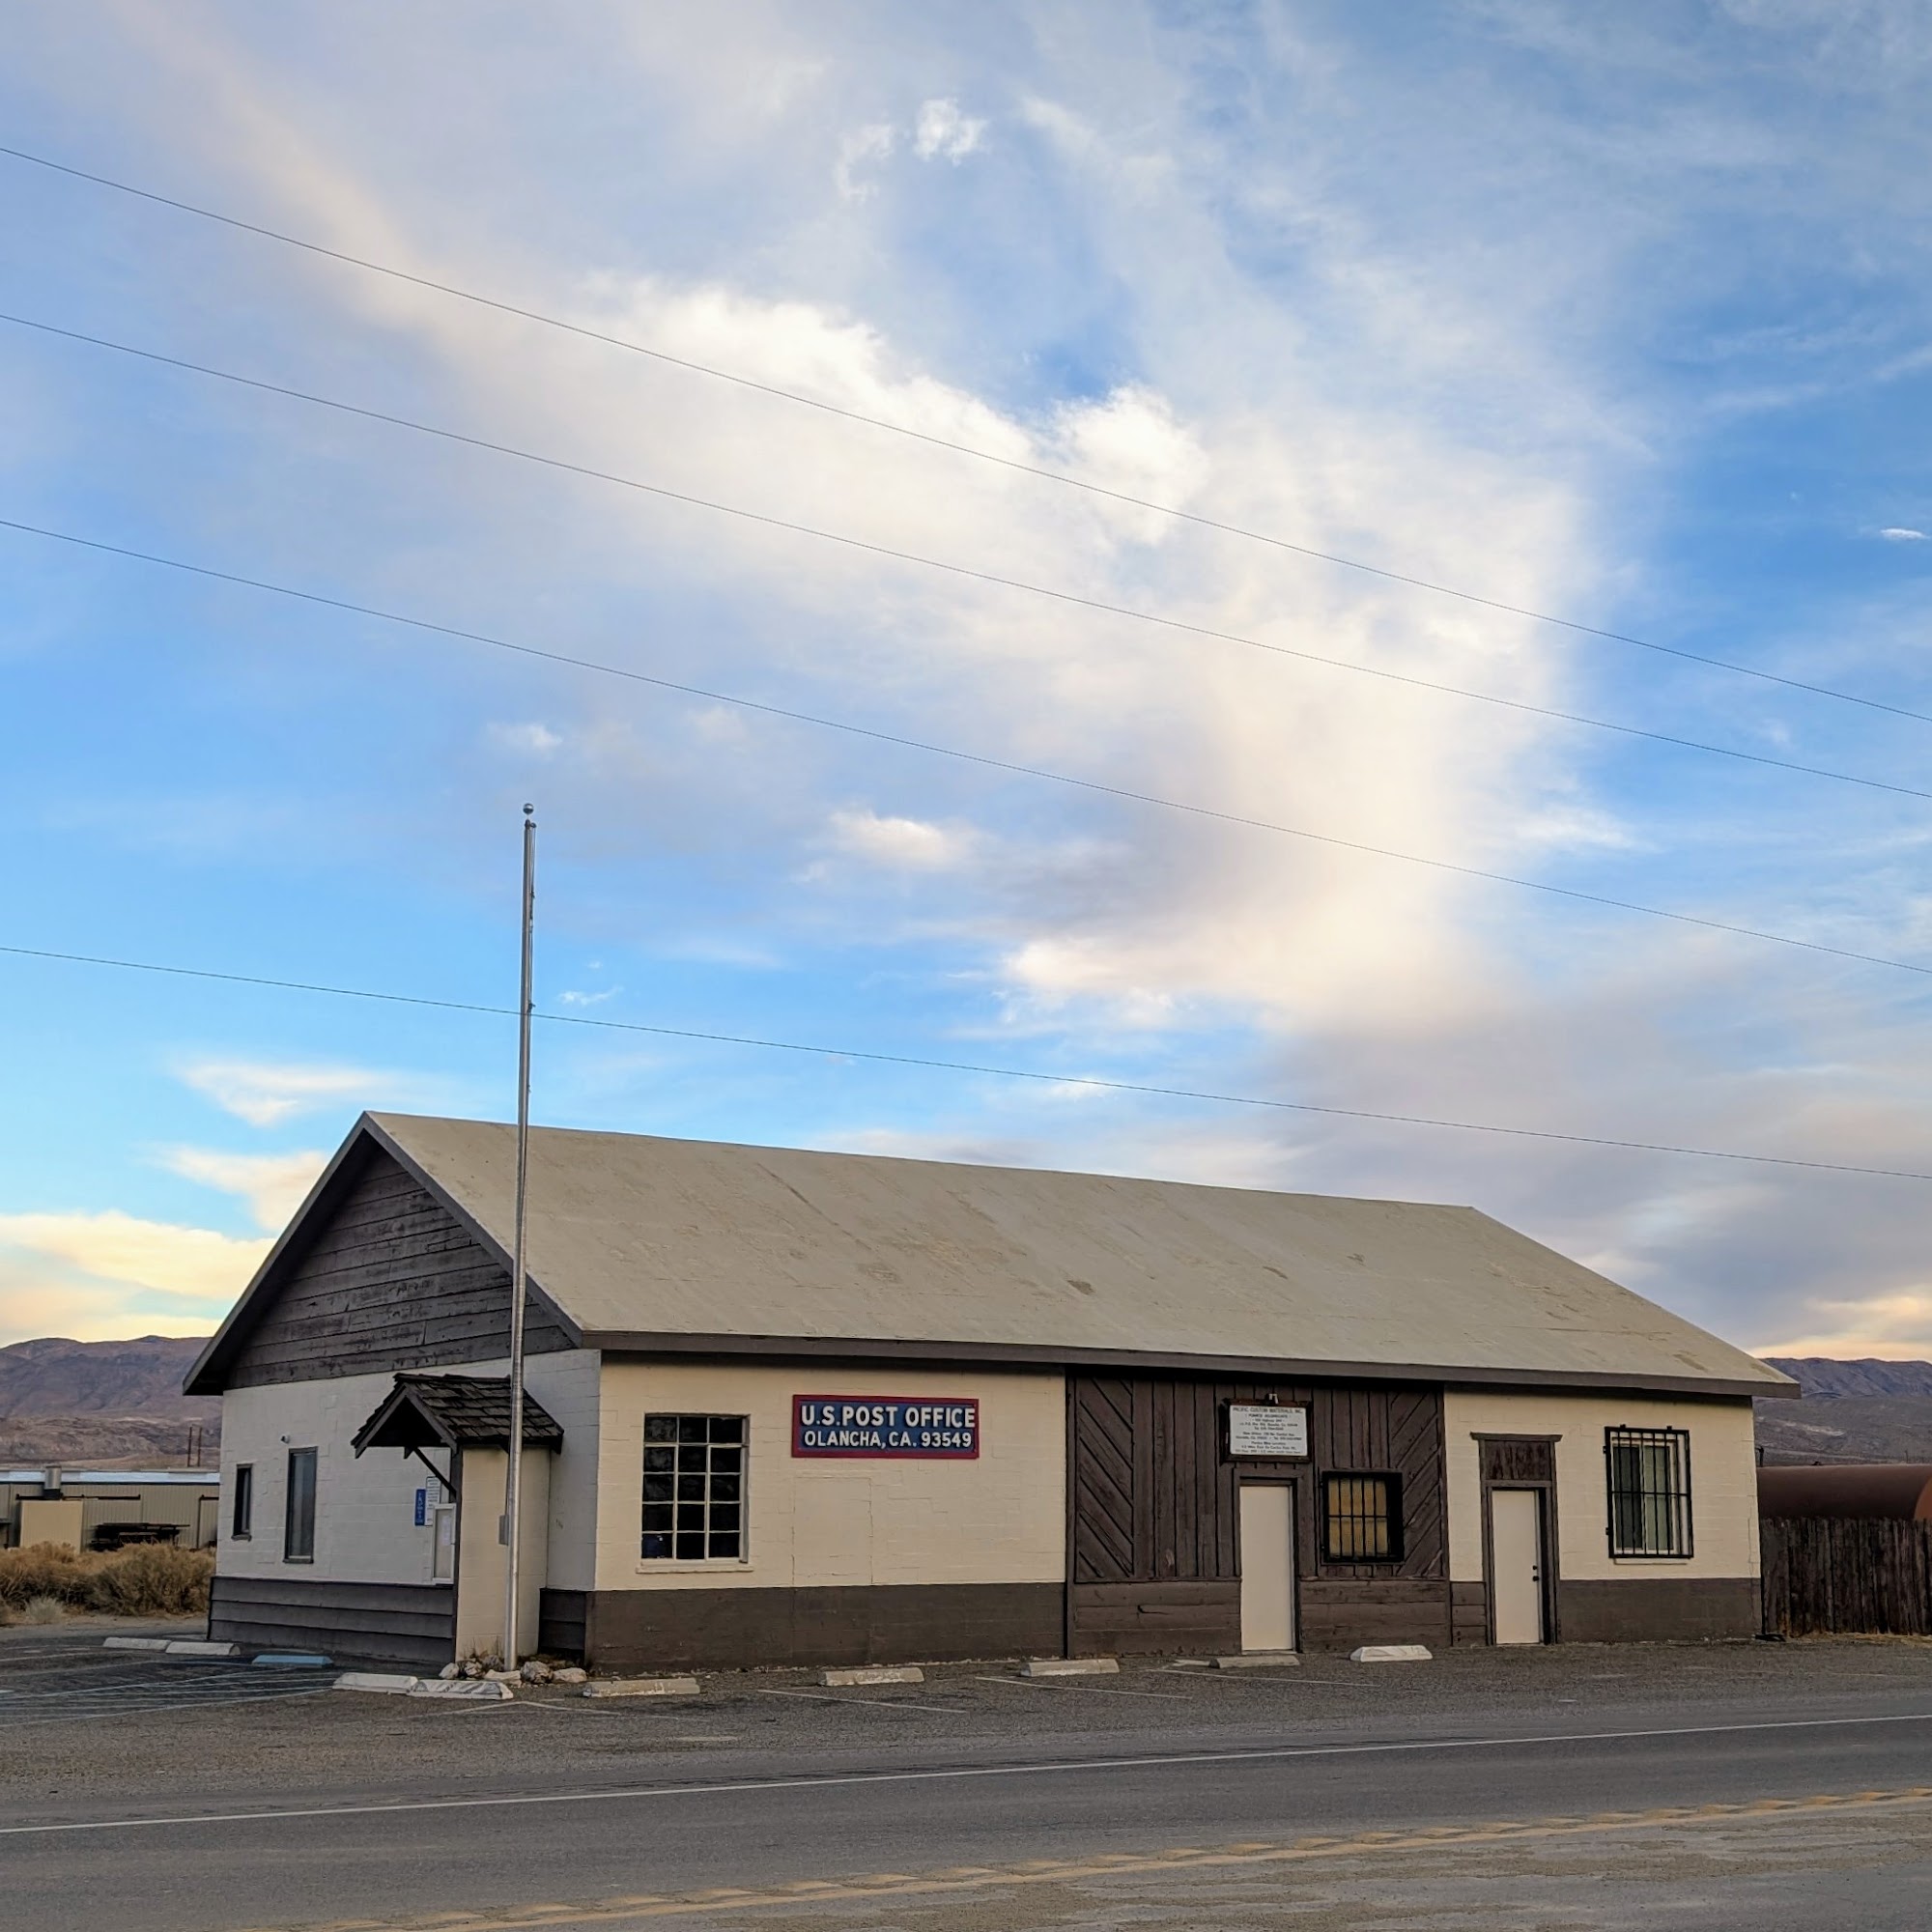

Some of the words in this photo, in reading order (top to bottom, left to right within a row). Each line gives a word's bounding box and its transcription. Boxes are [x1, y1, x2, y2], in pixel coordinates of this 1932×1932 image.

[905, 1406, 976, 1428] OFFICE
[889, 1432, 918, 1447] CA.
[921, 1432, 972, 1448] 93549
